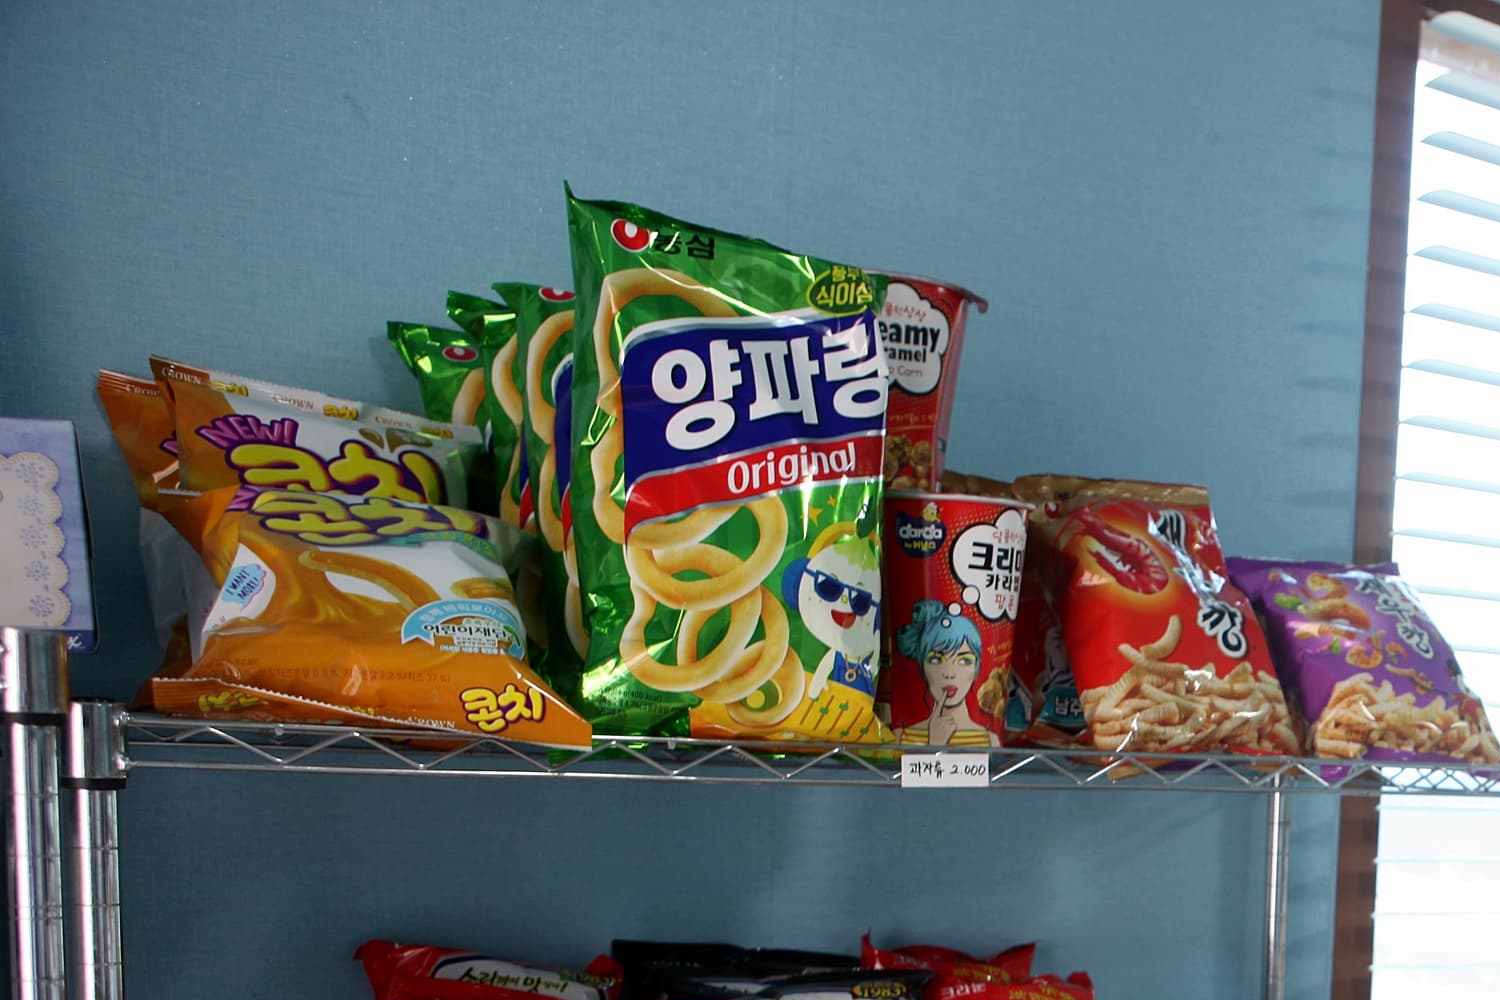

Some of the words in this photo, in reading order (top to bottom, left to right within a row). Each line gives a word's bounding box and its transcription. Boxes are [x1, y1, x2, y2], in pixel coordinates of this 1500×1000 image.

[162, 367, 201, 384] CROWN
[272, 394, 314, 410] CROWN
[652, 322, 889, 450] 양파링
[199, 415, 299, 447] NEW!
[727, 442, 857, 494] Original
[899, 525, 943, 539] darda
[461, 684, 547, 734] 콘치
[909, 761, 945, 780] 과자류
